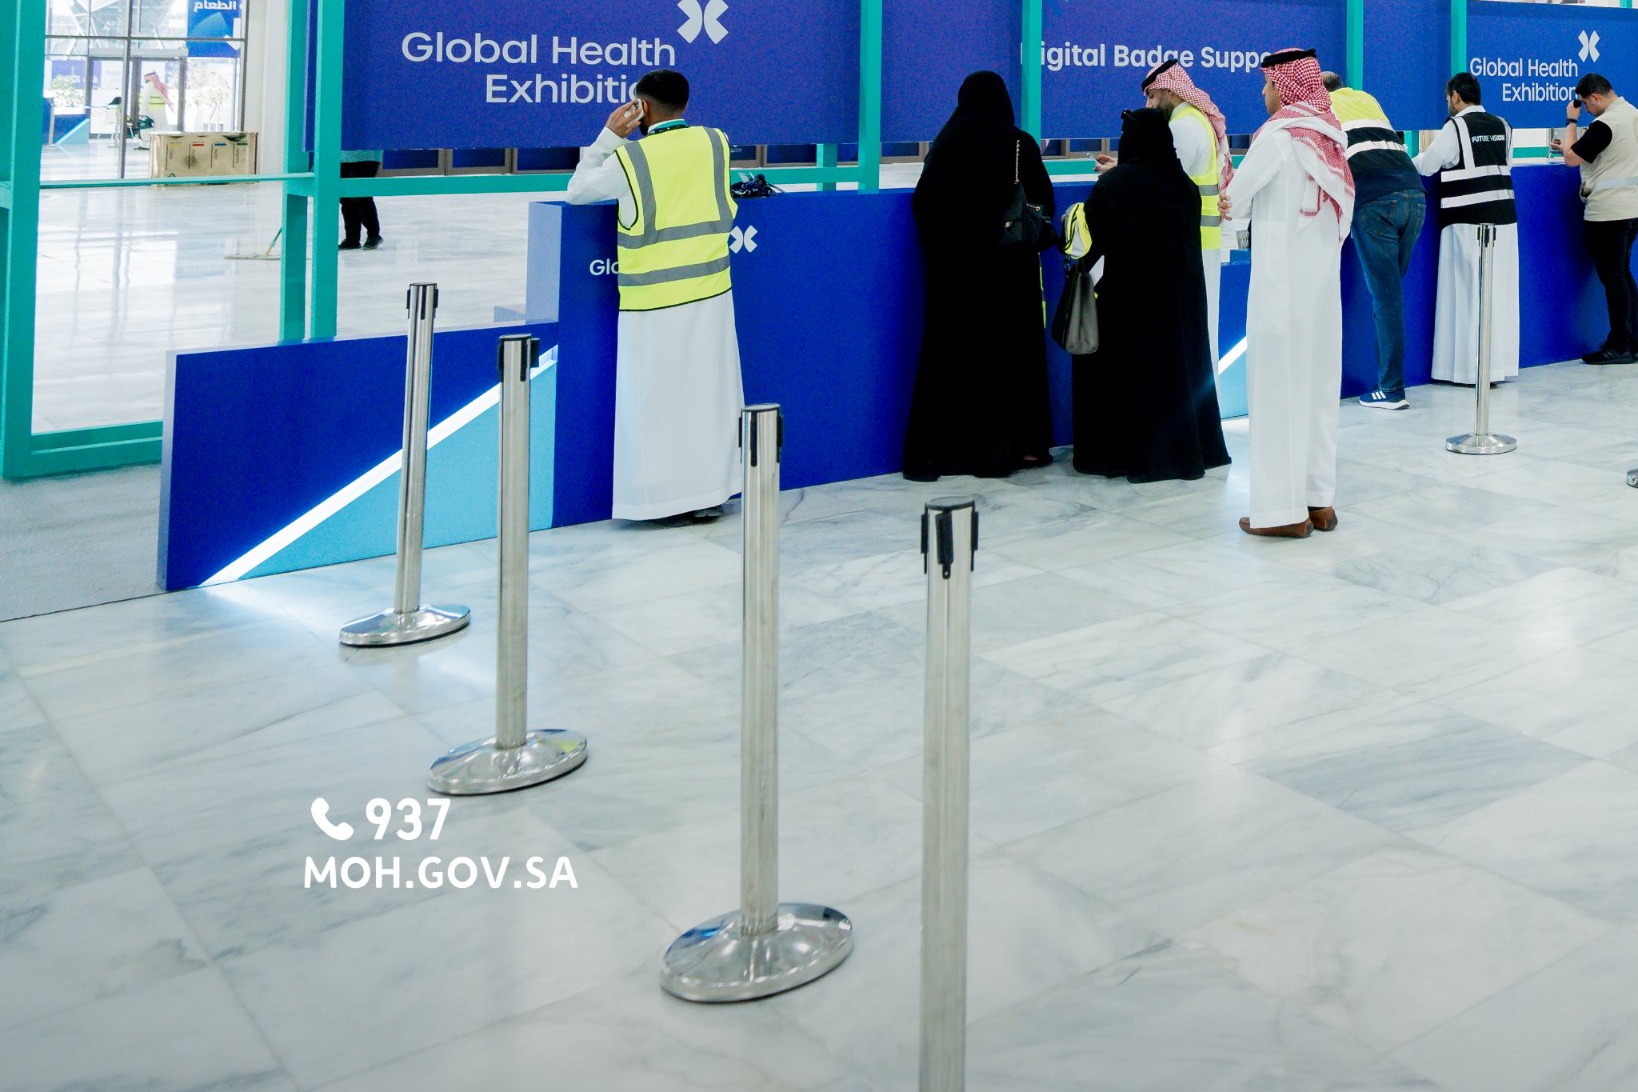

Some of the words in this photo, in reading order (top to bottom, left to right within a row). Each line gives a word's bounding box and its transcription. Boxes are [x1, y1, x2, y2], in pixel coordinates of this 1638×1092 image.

[194, 0, 237, 13] الطعام
[401, 31, 537, 64] Global
[552, 34, 675, 66] Health
[1020, 40, 1106, 72] igital
[1113, 45, 1194, 69] Badge
[1469, 57, 1523, 77] Global
[1527, 58, 1579, 77] Health
[486, 73, 638, 104] Exhibiti
[1471, 134, 1490, 143] FUTURE
